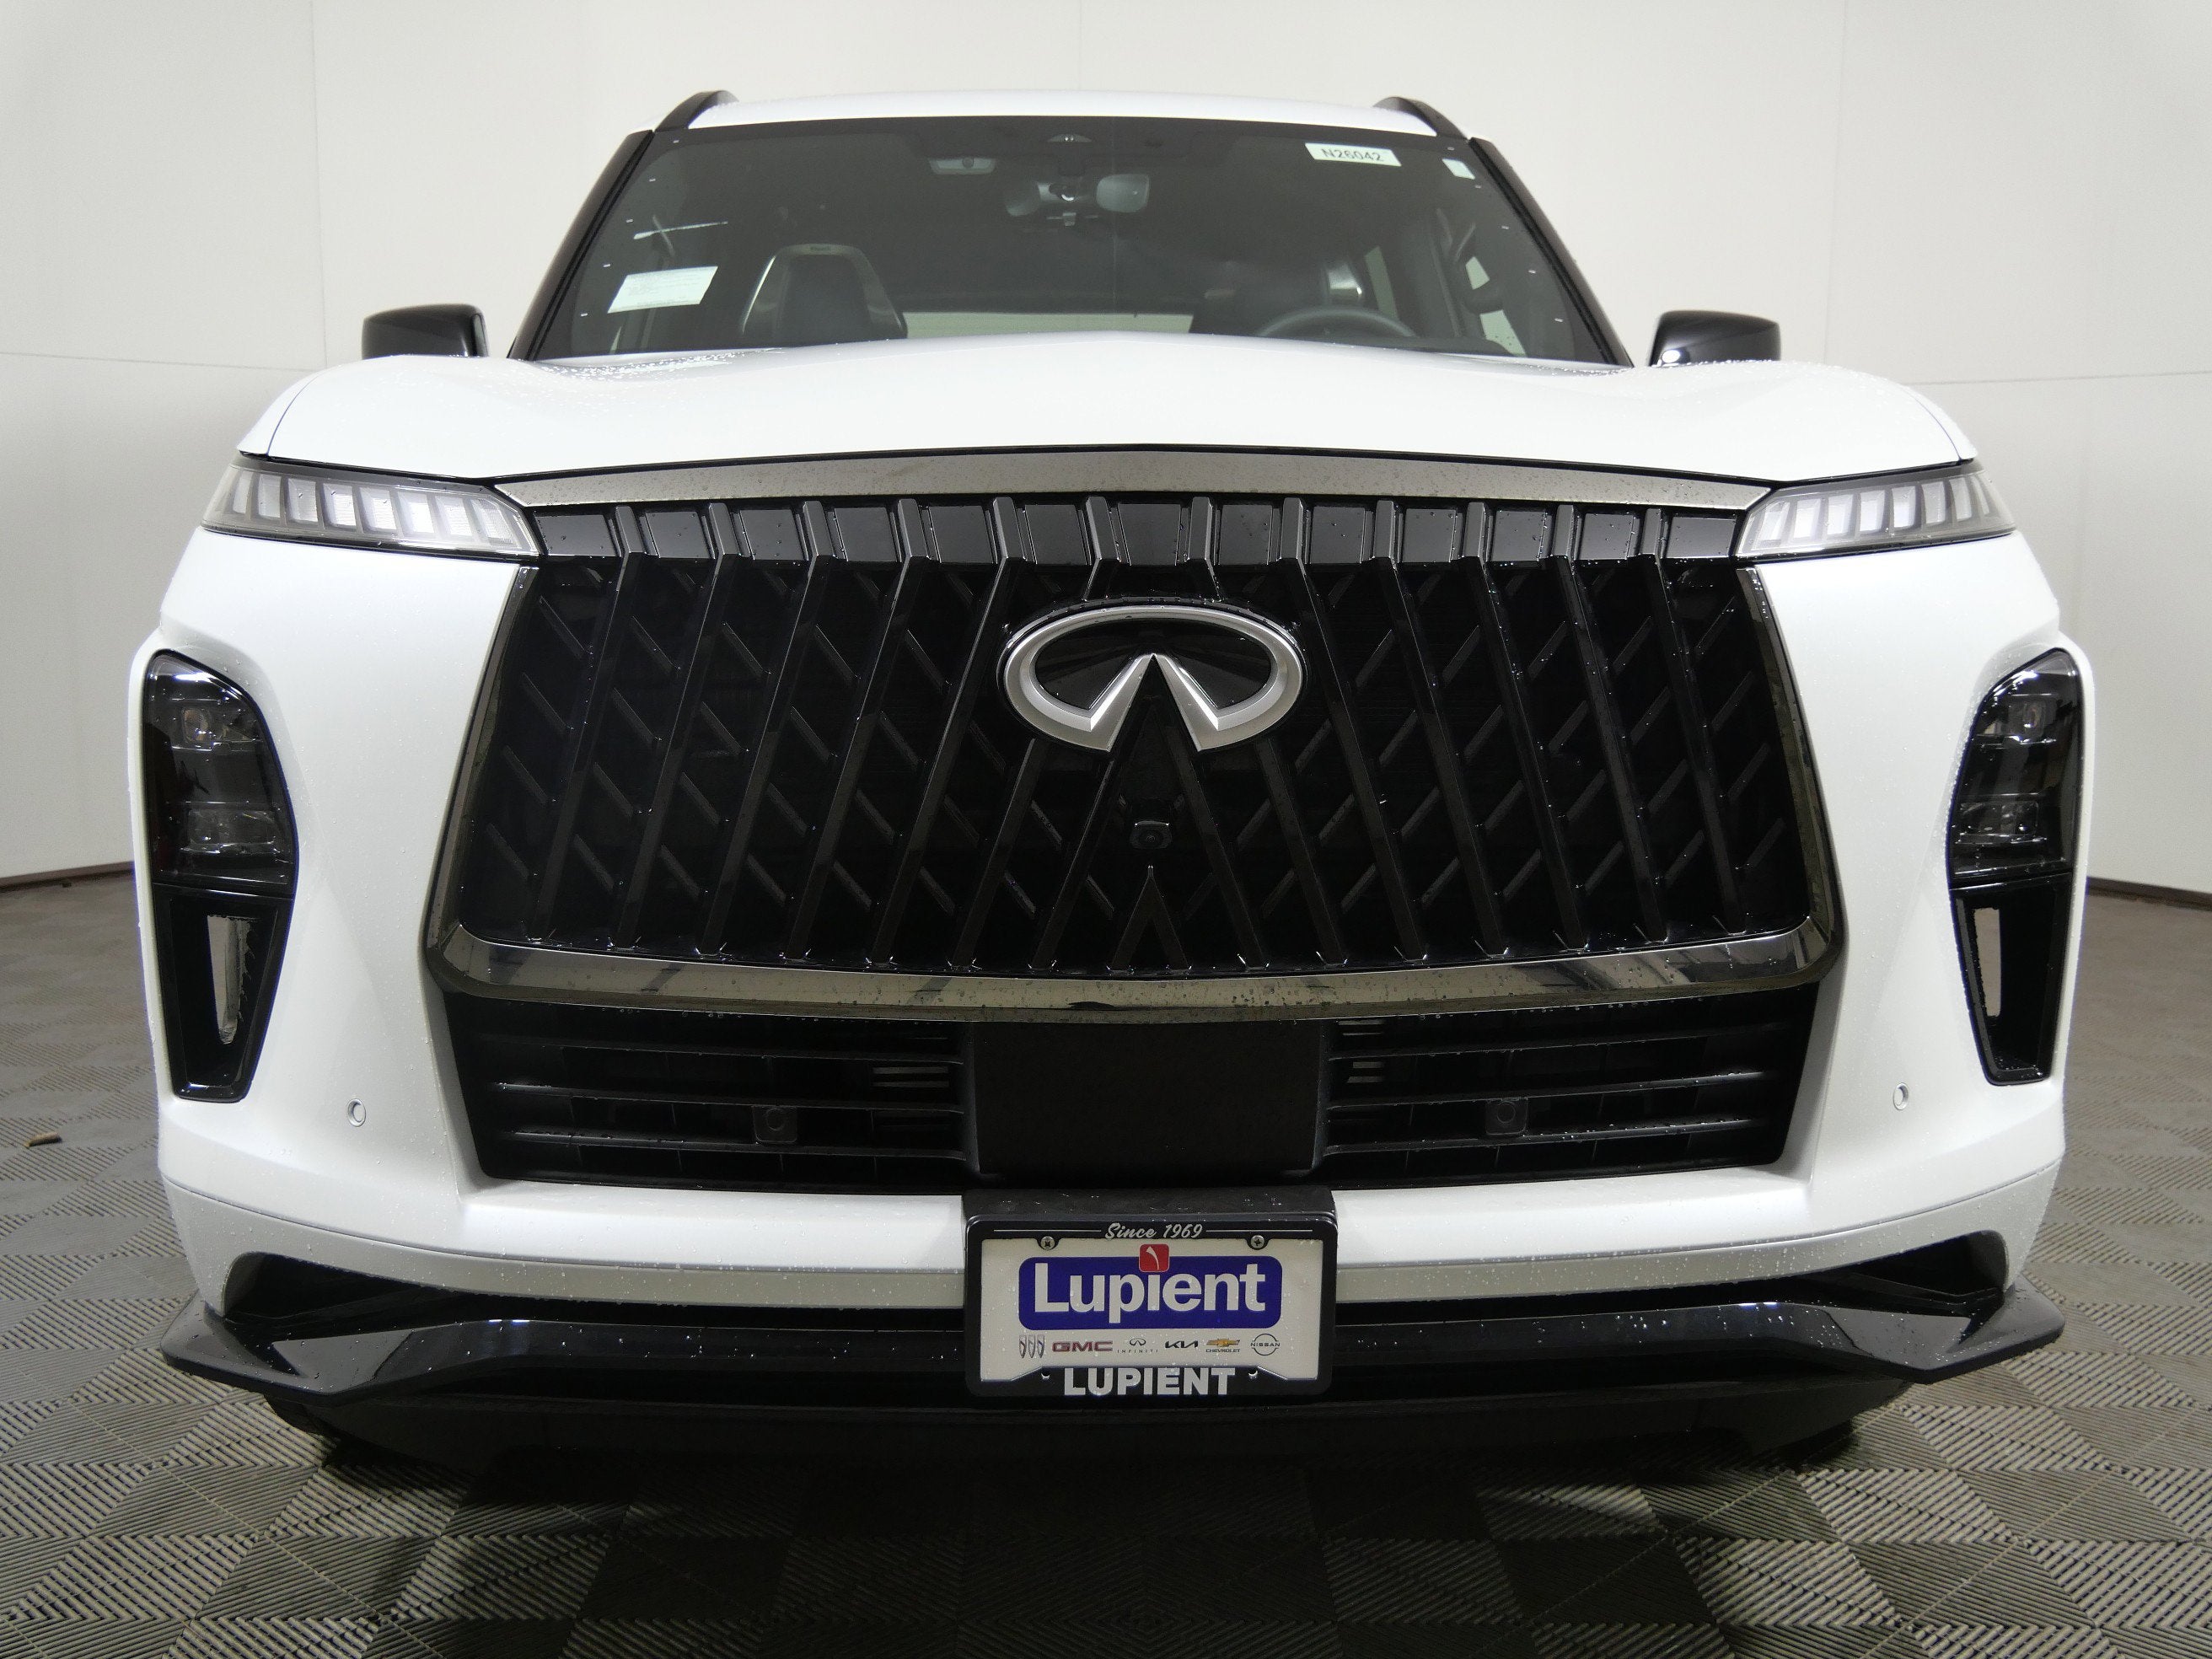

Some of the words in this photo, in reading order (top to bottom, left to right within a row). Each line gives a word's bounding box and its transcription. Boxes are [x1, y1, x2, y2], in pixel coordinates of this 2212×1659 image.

[1321, 148, 1384, 162] N26042
[1104, 1222, 1157, 1239] Since
[1163, 1223, 1203, 1239] 1969
[1034, 1262, 1265, 1323] Lupient
[1051, 1340, 1113, 1352] GMC
[1064, 1367, 1236, 1396] LUPIENT
